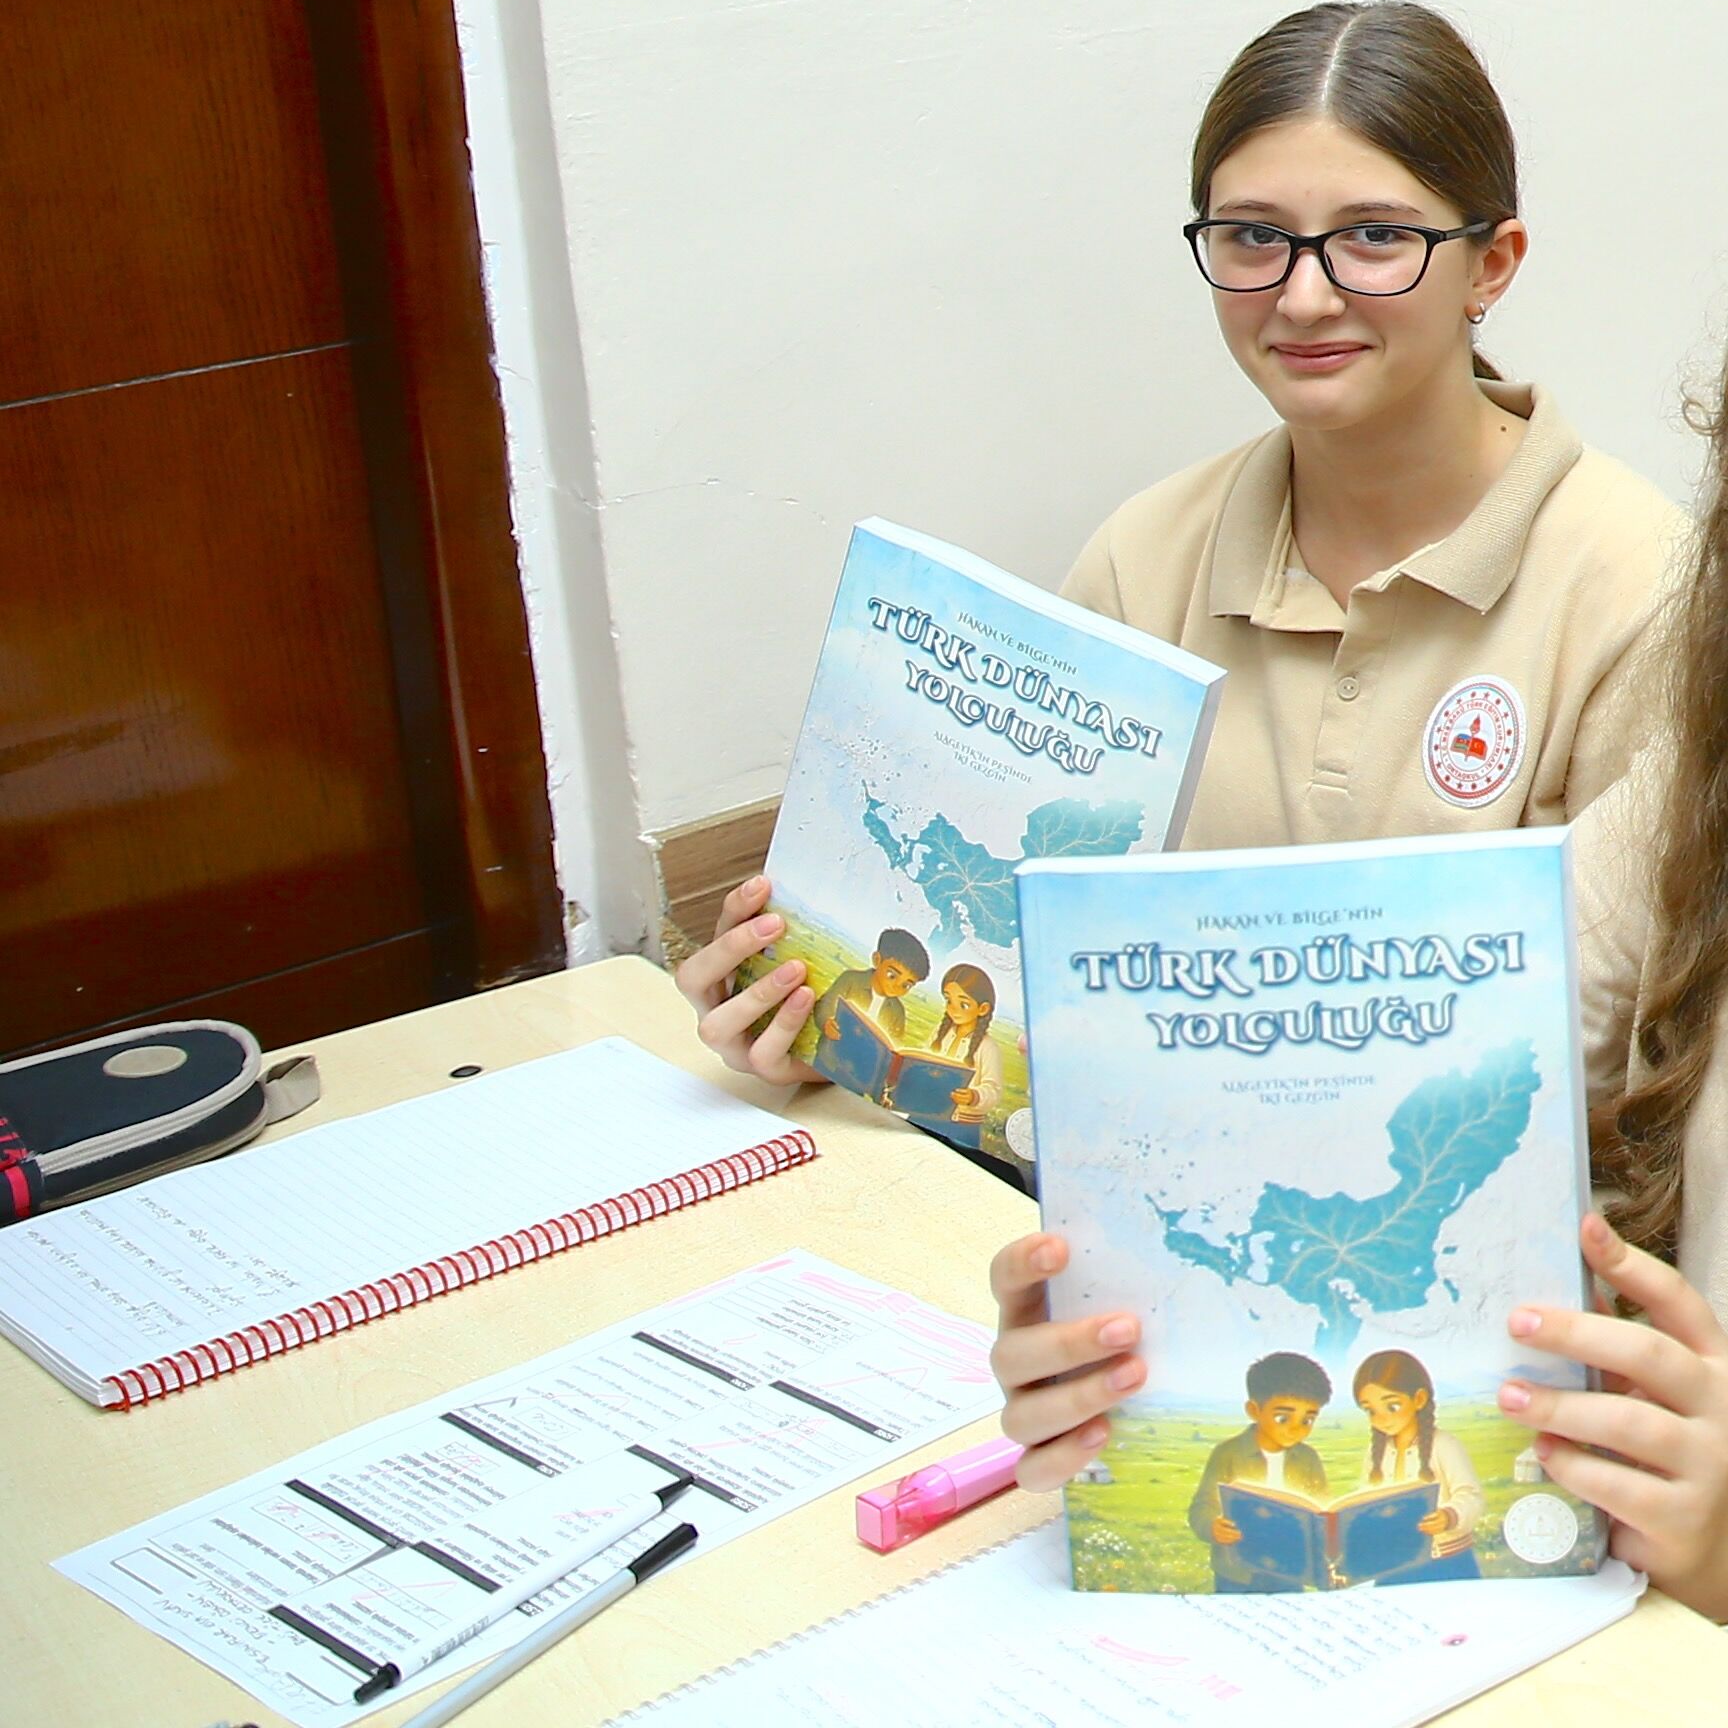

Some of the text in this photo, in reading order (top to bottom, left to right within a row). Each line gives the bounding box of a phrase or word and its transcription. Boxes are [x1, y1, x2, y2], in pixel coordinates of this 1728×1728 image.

[957, 610, 1078, 675] HAKAN VE BİLGE'NİN
[868, 596, 1163, 758] TÜRK DÜNYASI
[905, 659, 1105, 775] YOLCULUĞU
[1196, 906, 1384, 932] HAKAN VE BİLGE'NİN
[1071, 931, 1526, 998] TÜRK DÜNYASI
[1147, 992, 1458, 1055] YOLCULUĞU
